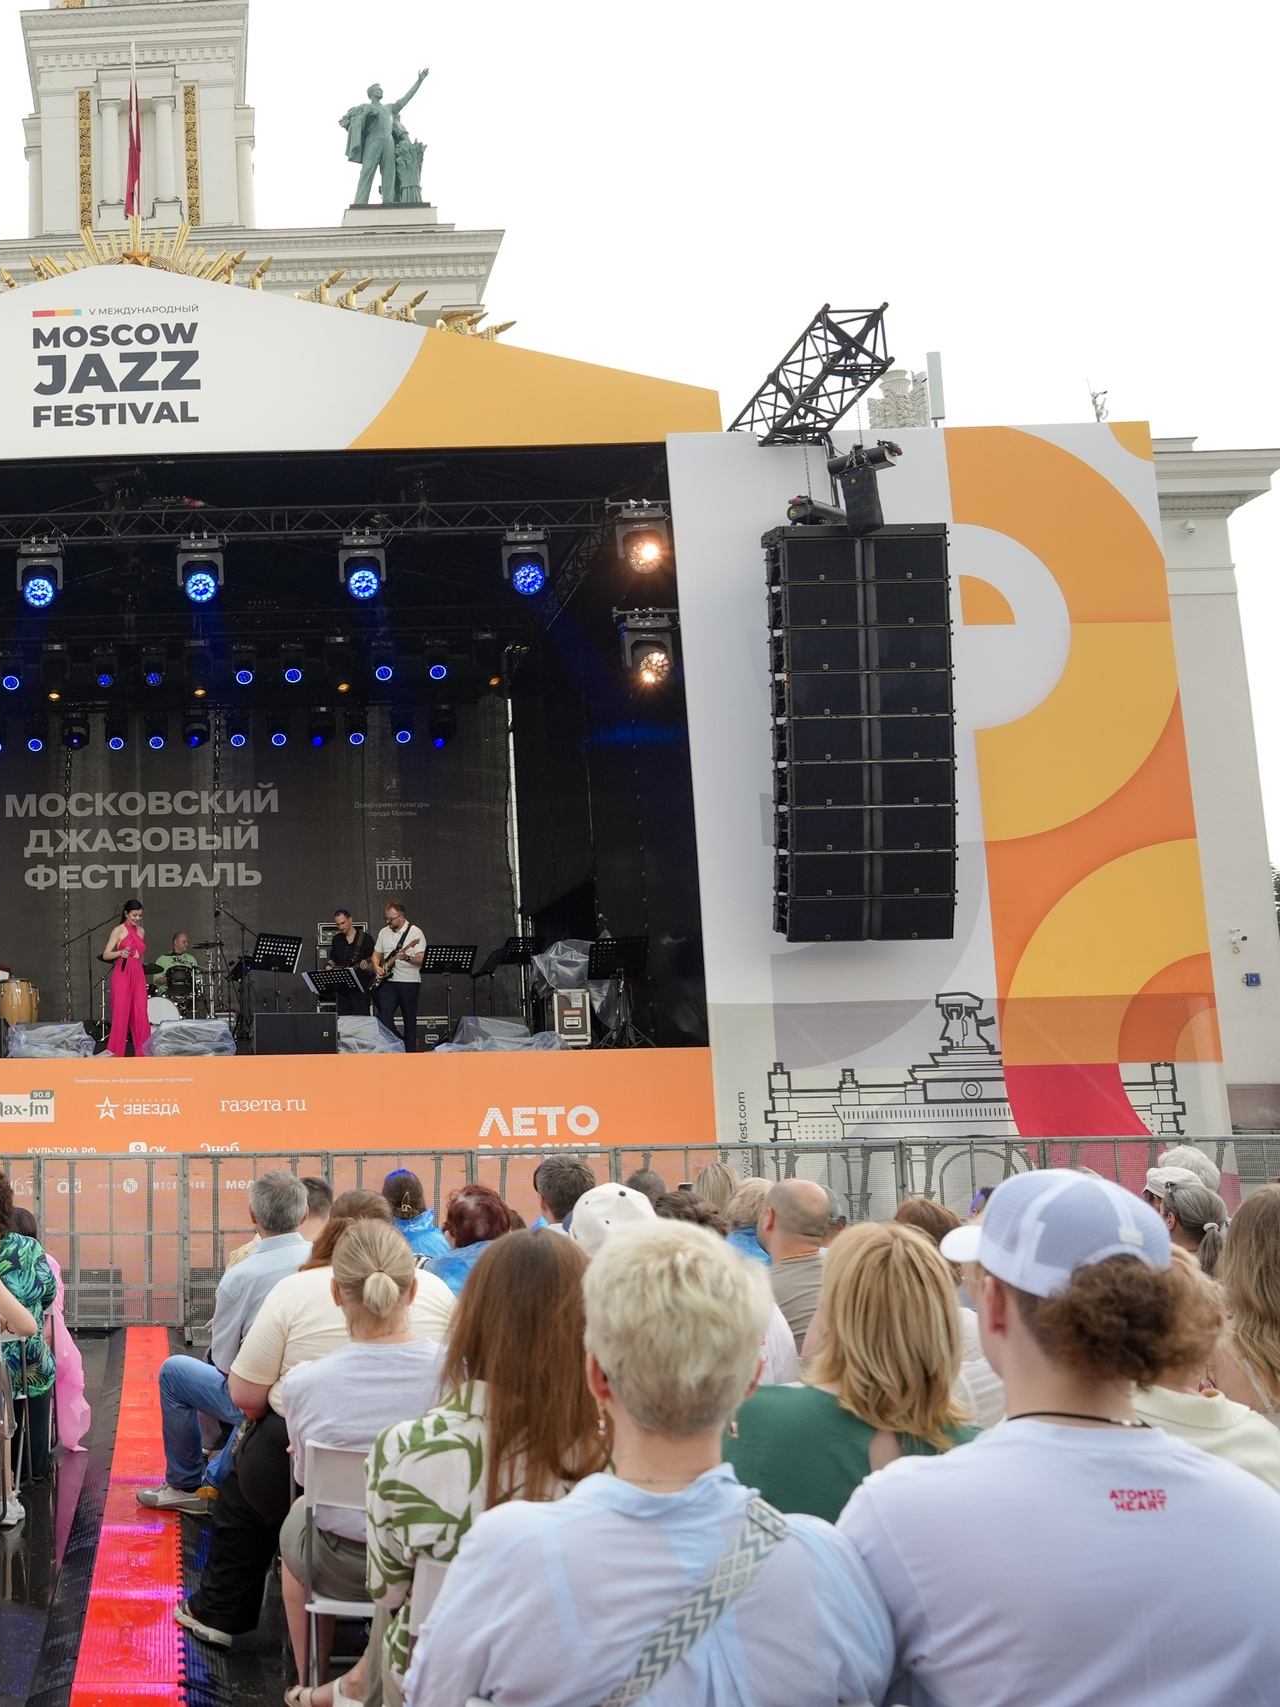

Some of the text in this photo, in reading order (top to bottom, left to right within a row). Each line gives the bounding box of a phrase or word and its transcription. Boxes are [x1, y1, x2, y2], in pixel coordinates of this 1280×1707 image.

[98, 304, 199, 316] МЕЖДУНАРОДНЫЙ
[32, 322, 199, 349] MOSCOW
[33, 350, 202, 396] JAZZ
[32, 401, 200, 428] FESTIVAL
[5, 782, 280, 818] МОСКОВСКИЙ
[23, 819, 260, 858] ДЖАЗОВЫЙ
[24, 862, 263, 890] ФЕСТИВАЛЬ
[376, 881, 413, 890] ВДНХ
[123, 1103, 181, 1116] ЗВЕЗДА
[220, 1099, 307, 1112] газета.ru
[478, 1105, 600, 1137] ЛЕТО
[1109, 1489, 1167, 1499] ATOMIC
[1114, 1500, 1166, 1511] HEART
